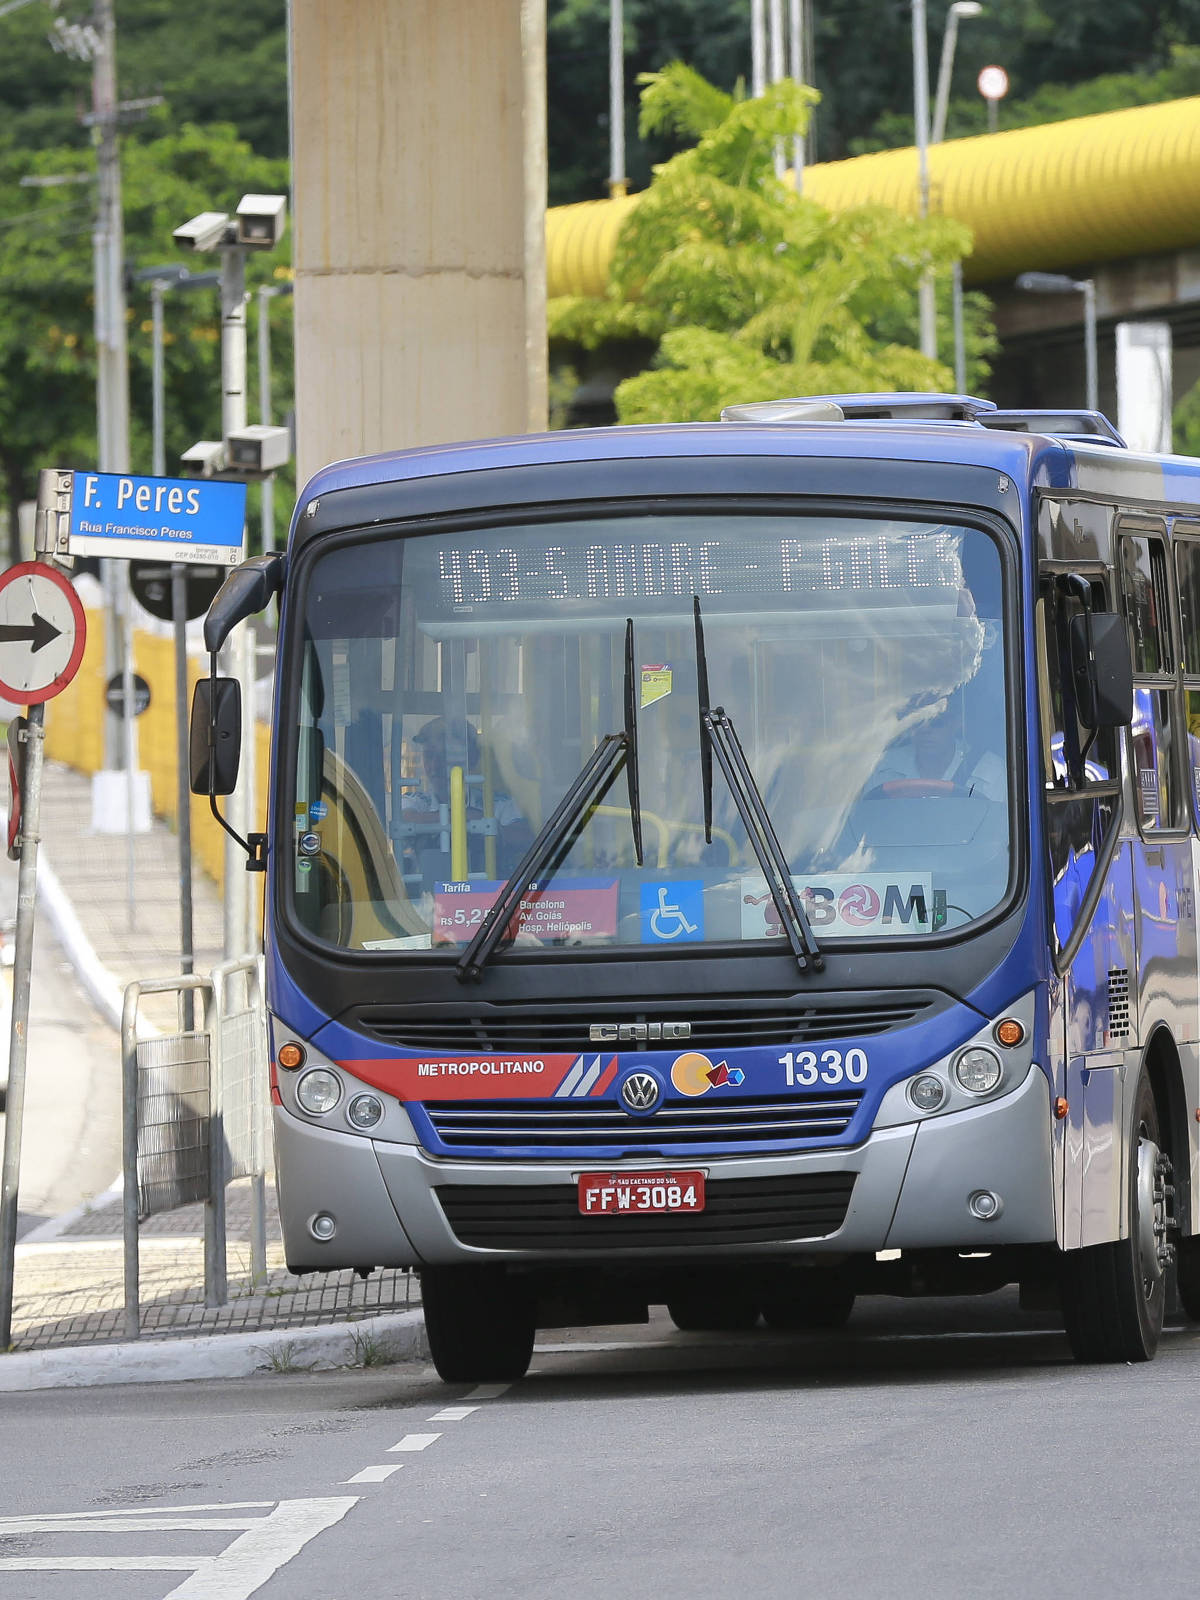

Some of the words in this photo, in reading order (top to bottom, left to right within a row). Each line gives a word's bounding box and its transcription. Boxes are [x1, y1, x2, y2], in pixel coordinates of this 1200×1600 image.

[84, 476, 102, 508] F.
[117, 478, 201, 515] Peres
[79, 521, 102, 533] Rua
[105, 522, 158, 537] Francisco
[160, 526, 193, 539] Peres
[229, 554, 237, 563] 6
[442, 883, 471, 893] Tarifa
[519, 900, 565, 910] Barcelona
[440, 917, 453, 926] R$
[519, 912, 534, 921] Av.
[536, 911, 562, 921] Goiás
[518, 923, 544, 934] Hosp.
[546, 921, 592, 934] Heliópolis
[589, 1022, 692, 1042] CAIO
[417, 1060, 545, 1076] METROPOLITANO
[777, 1048, 868, 1087] 1330
[665, 1176, 678, 1184] SUL
